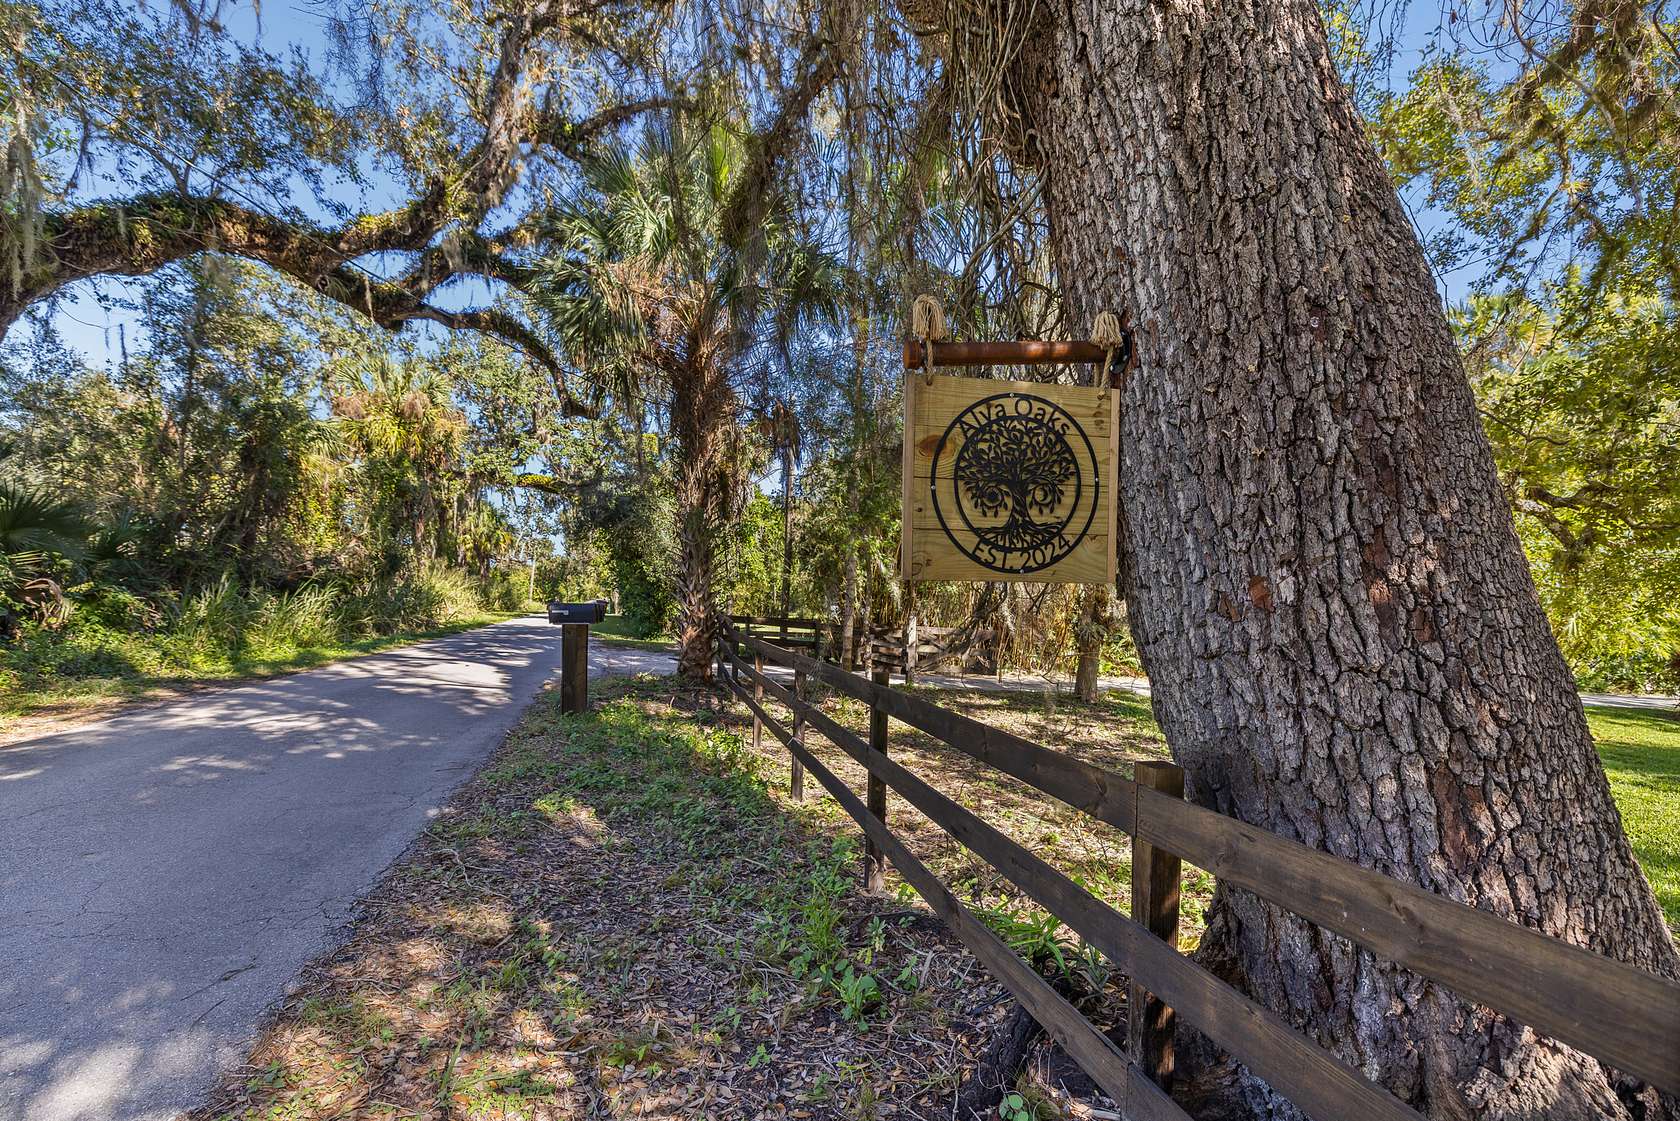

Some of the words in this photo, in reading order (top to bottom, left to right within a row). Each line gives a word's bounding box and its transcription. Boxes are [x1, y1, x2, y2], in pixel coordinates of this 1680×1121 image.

[959, 402, 1007, 440] Alva
[1014, 399, 1070, 436] Oaks
[971, 539, 1014, 569] EST.
[1020, 537, 1073, 568] 2024
